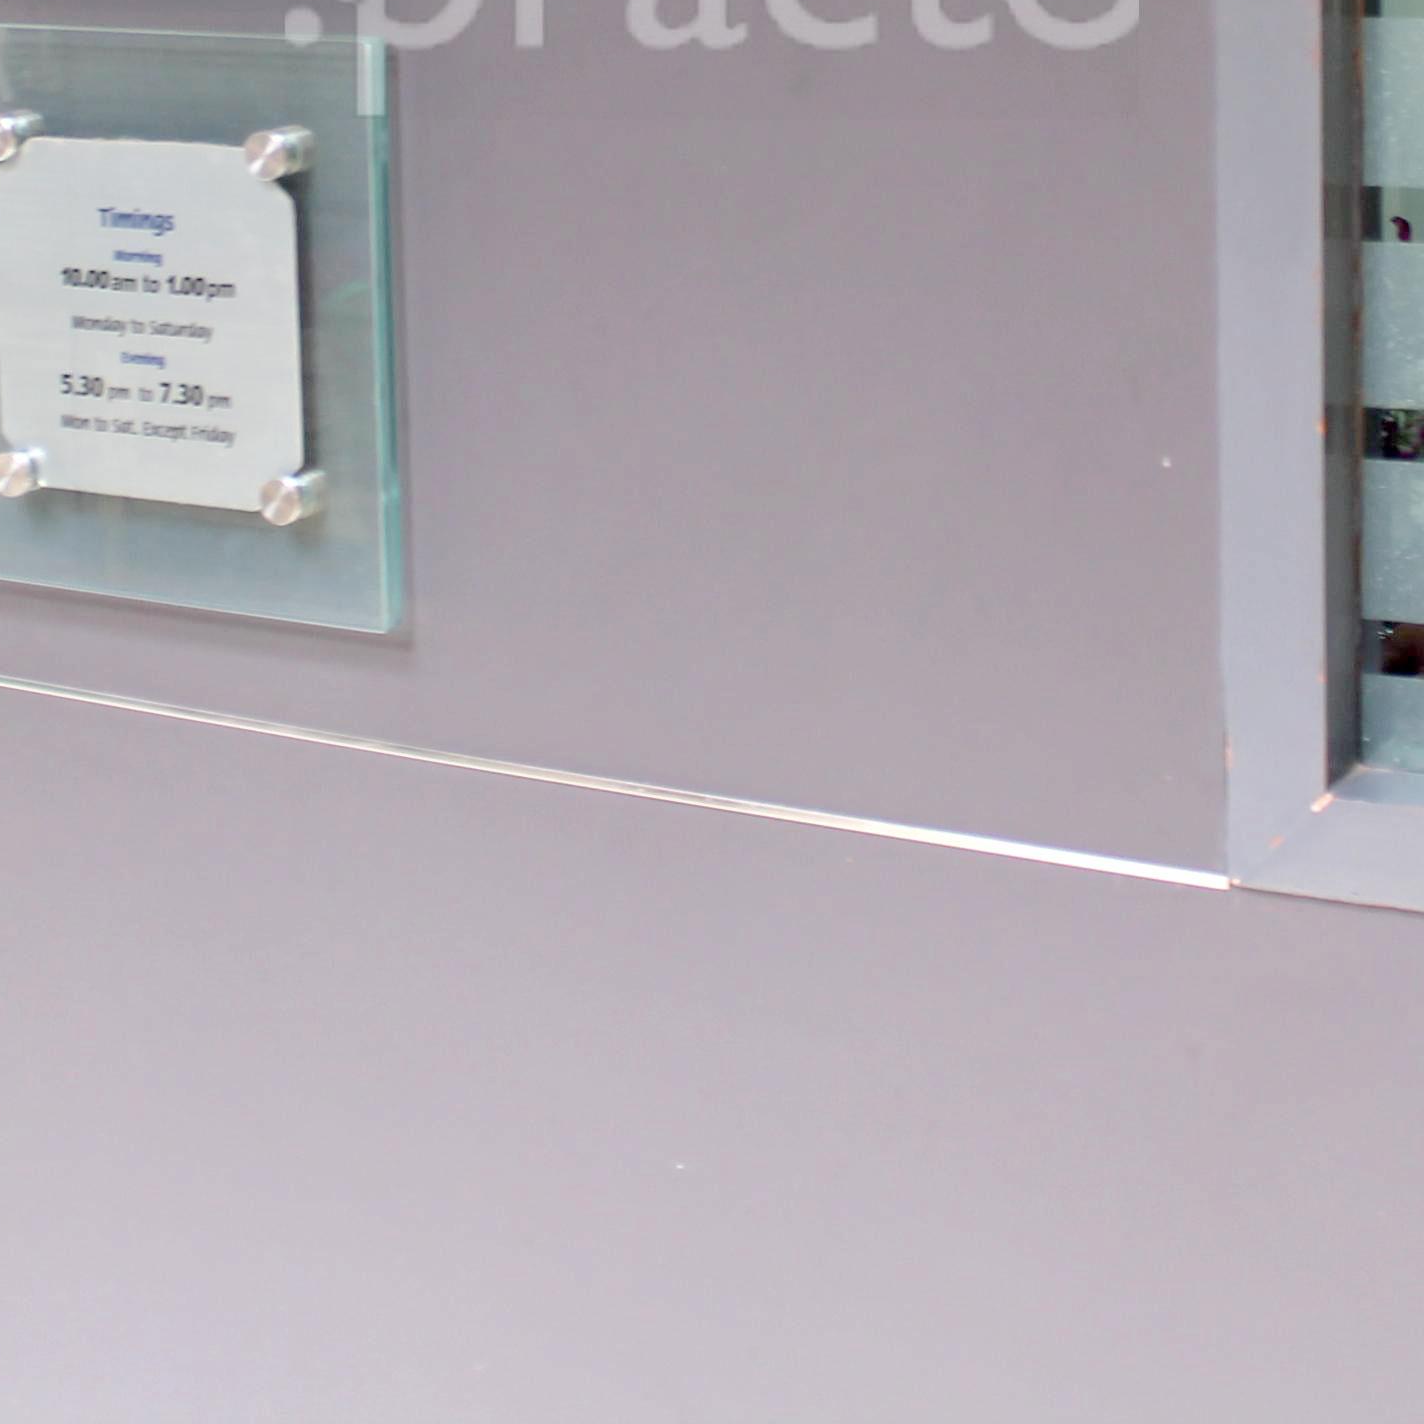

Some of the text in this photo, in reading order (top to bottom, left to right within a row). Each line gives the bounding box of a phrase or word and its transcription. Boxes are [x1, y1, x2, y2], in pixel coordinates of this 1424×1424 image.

[96, 206, 175, 236] Timings
[141, 275, 161, 294] to
[71, 315, 214, 344] Monday to Saturday
[60, 373, 232, 411] 5.30 pm to 7.30 pm
[60, 414, 90, 430] Mon
[94, 417, 110, 432] to
[142, 421, 187, 442] Except
[191, 425, 237, 449] Friday
